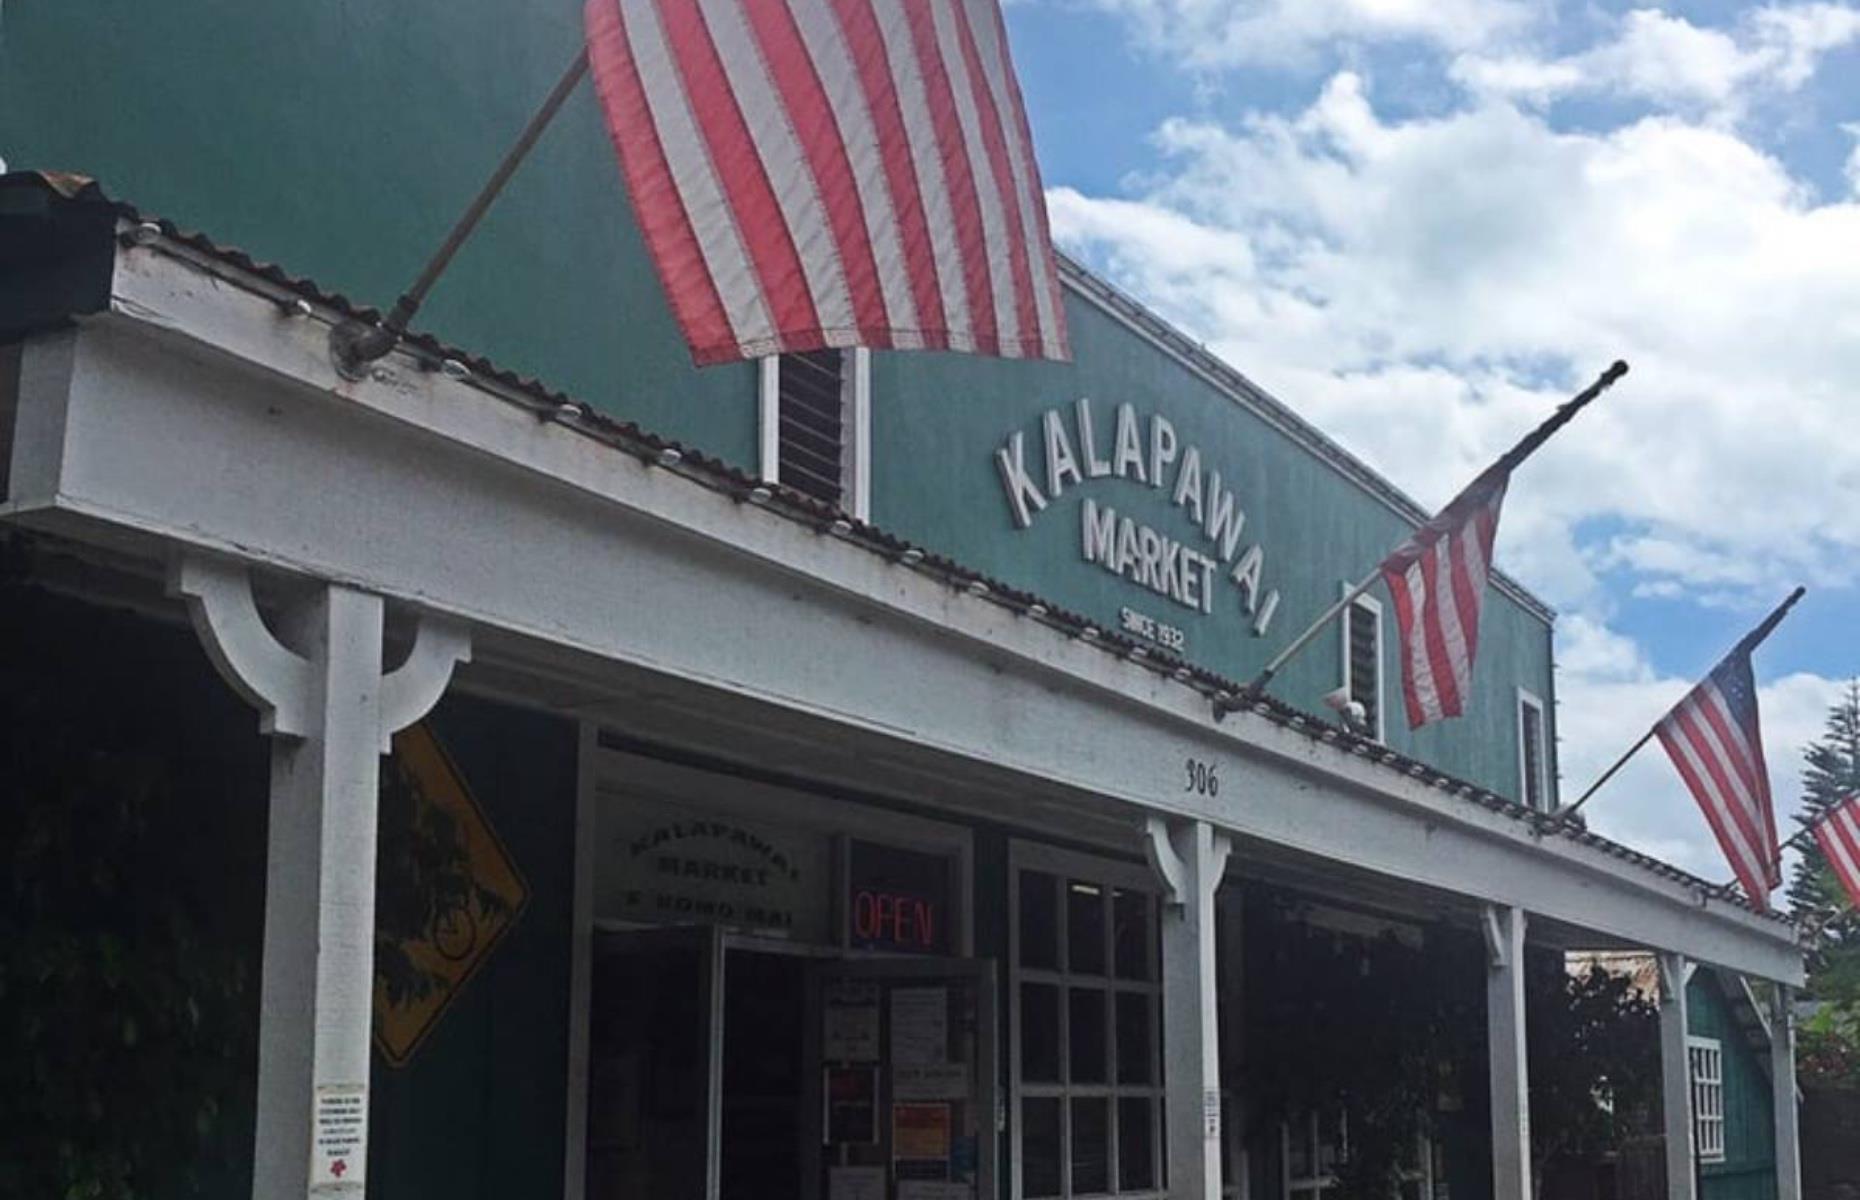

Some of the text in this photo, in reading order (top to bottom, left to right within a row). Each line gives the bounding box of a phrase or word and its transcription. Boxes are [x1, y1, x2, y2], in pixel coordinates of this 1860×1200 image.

[995, 397, 1281, 637] KALAPAWAI
[1081, 498, 1217, 615] MARKET
[1121, 606, 1184, 653] SINCE 1932
[1185, 757, 1219, 797] 306
[657, 855, 769, 887] MARKET
[854, 889, 936, 946] OPEN
